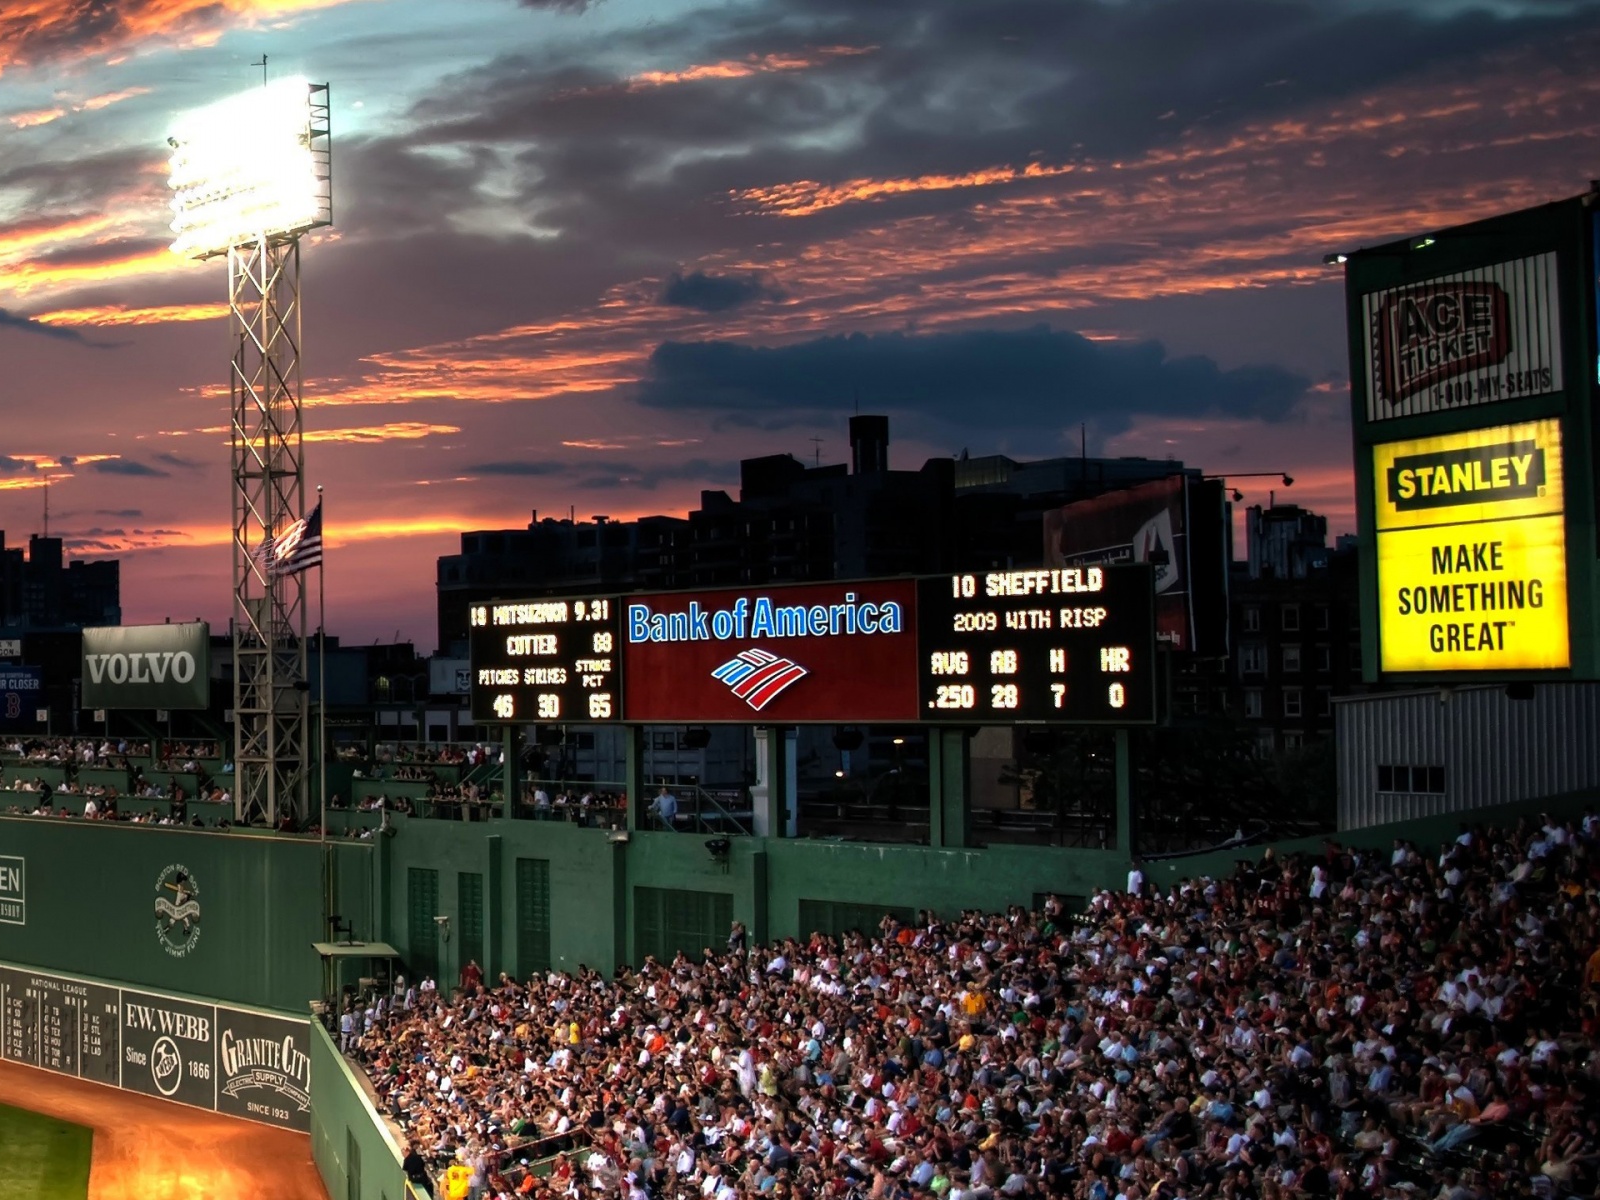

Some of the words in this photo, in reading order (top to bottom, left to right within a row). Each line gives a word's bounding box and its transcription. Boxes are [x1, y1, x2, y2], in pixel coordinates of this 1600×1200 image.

[1400, 293, 1493, 347] ACE
[1401, 331, 1492, 381] TICKET
[1398, 454, 1532, 499] STANLEY
[1431, 541, 1504, 575] MAKE
[953, 575, 975, 598] 10
[985, 567, 1103, 597] SHEFFIELD
[1398, 579, 1543, 615] SOMETHING
[493, 602, 567, 625] MATSUZAKA
[574, 600, 608, 621] 9.31
[629, 601, 709, 643] Bank
[712, 597, 748, 640] of
[751, 592, 901, 638] America
[954, 612, 997, 632] 2009
[1005, 609, 1050, 630] WITH
[1060, 607, 1106, 629] RISP
[85, 651, 195, 684] VOLVO
[575, 659, 611, 672] STRIKE
[931, 651, 968, 675] AVG
[990, 649, 1017, 674] AB
[1050, 648, 1065, 673] H
[1100, 647, 1130, 672] HR
[8, 679, 39, 690] CLOSER
[479, 669, 519, 685] PITCHES
[524, 668, 566, 685] STRIKES
[583, 675, 604, 688] PCT
[928, 685, 974, 708] .250
[991, 684, 1018, 708] 28
[1051, 683, 1065, 708] 7
[1108, 682, 1125, 708] 0
[493, 694, 513, 718] 46
[538, 694, 560, 718] 30
[589, 693, 611, 718] 65
[155, 864, 175, 892] BOSTON
[176, 863, 189, 876] RED
[189, 875, 200, 896] SOX
[187, 926, 201, 953] FUND
[31, 977, 61, 991] NATIONAL
[62, 983, 87, 996] LEAGUE
[12, 998, 23, 1009] CHC
[52, 1006, 59, 1016] TB
[14, 1008, 21, 1018] SD
[50, 1016, 61, 1026] FLA
[92, 1015, 100, 1025] KC
[13, 1018, 22, 1029] BAL
[50, 1026, 61, 1037] TEX
[90, 1025, 101, 1036] STL
[126, 1003, 157, 1032] F.W.
[156, 1009, 210, 1043] WEBB
[12, 1038, 22, 1049] CLE
[50, 1037, 61, 1047] HOU
[90, 1035, 101, 1046] LAA
[13, 1048, 22, 1058] CIN
[51, 1047, 61, 1058] TOR
[90, 1046, 102, 1057] LAD
[221, 1028, 280, 1077] GRANITE
[51, 1057, 61, 1068] ATL
[126, 1046, 147, 1066] Since
[188, 1061, 210, 1080] 1866
[255, 1071, 284, 1085] SUPPLY
[247, 1101, 270, 1116] SINCE
[272, 1107, 289, 1120] 1923
